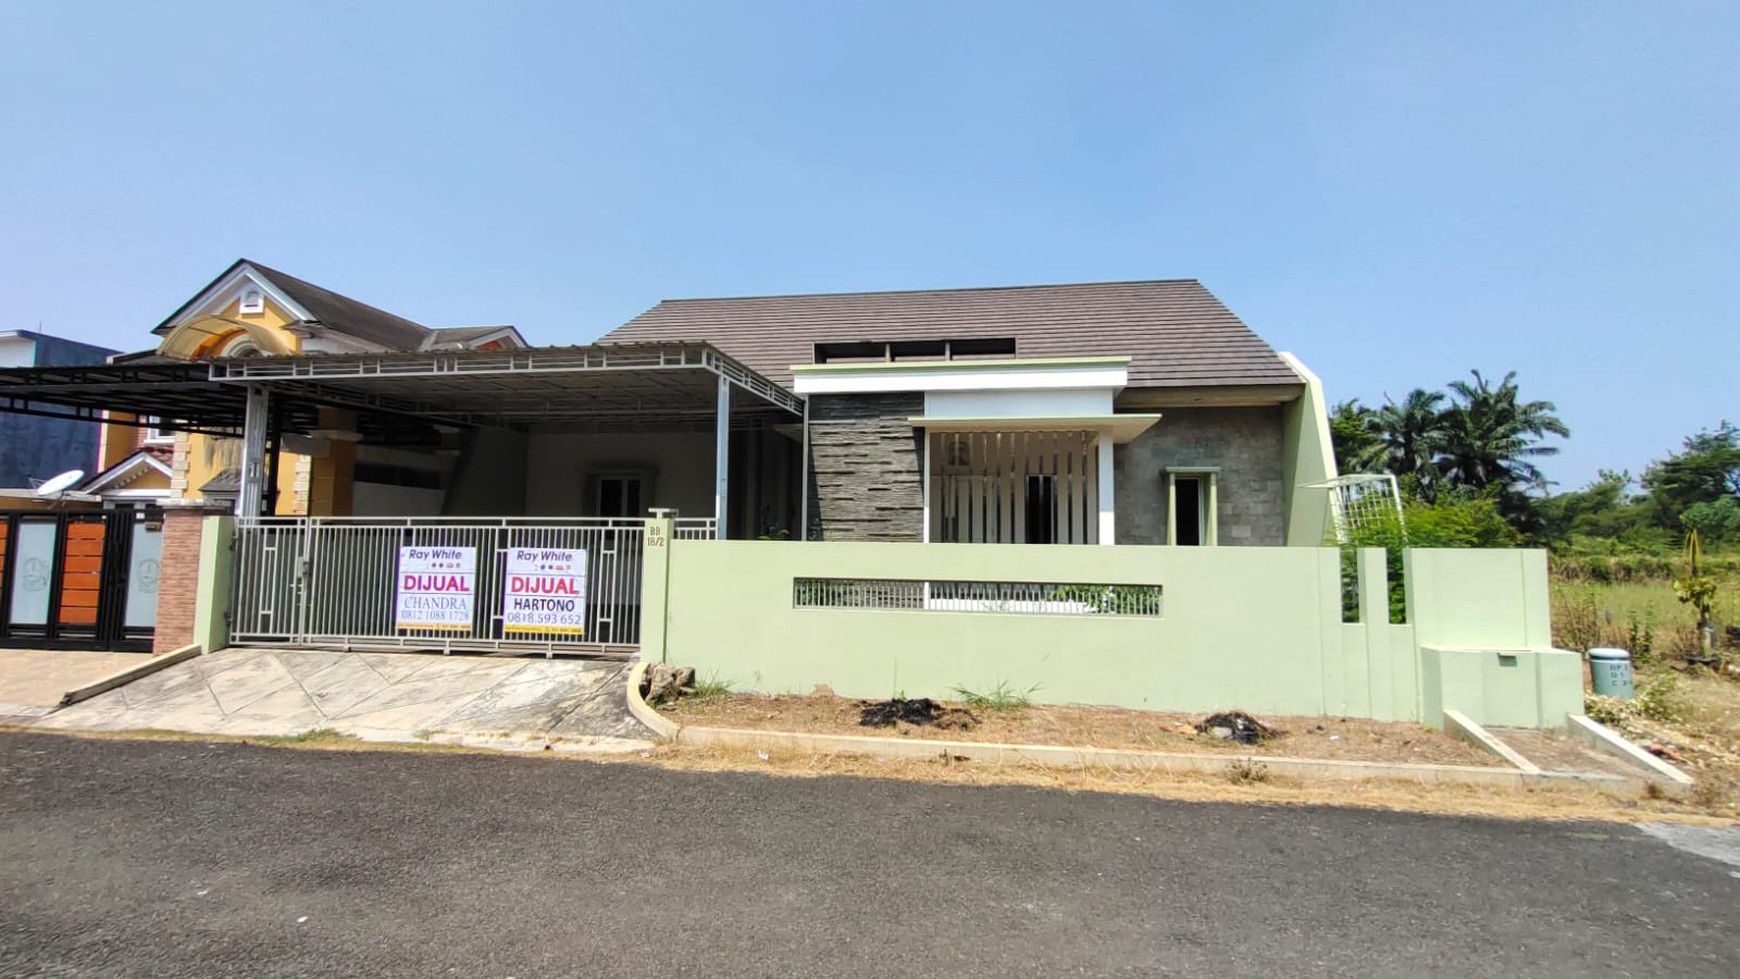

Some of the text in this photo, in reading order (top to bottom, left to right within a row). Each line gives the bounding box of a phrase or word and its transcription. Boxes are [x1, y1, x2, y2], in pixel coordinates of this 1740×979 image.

[408, 549, 462, 560] Ray White
[516, 550, 572, 562] Ray White
[403, 575, 470, 592] DIJUAL
[511, 576, 580, 595] DIJUAL
[404, 597, 467, 610] CHANDRA
[513, 598, 575, 612] HARTONO
